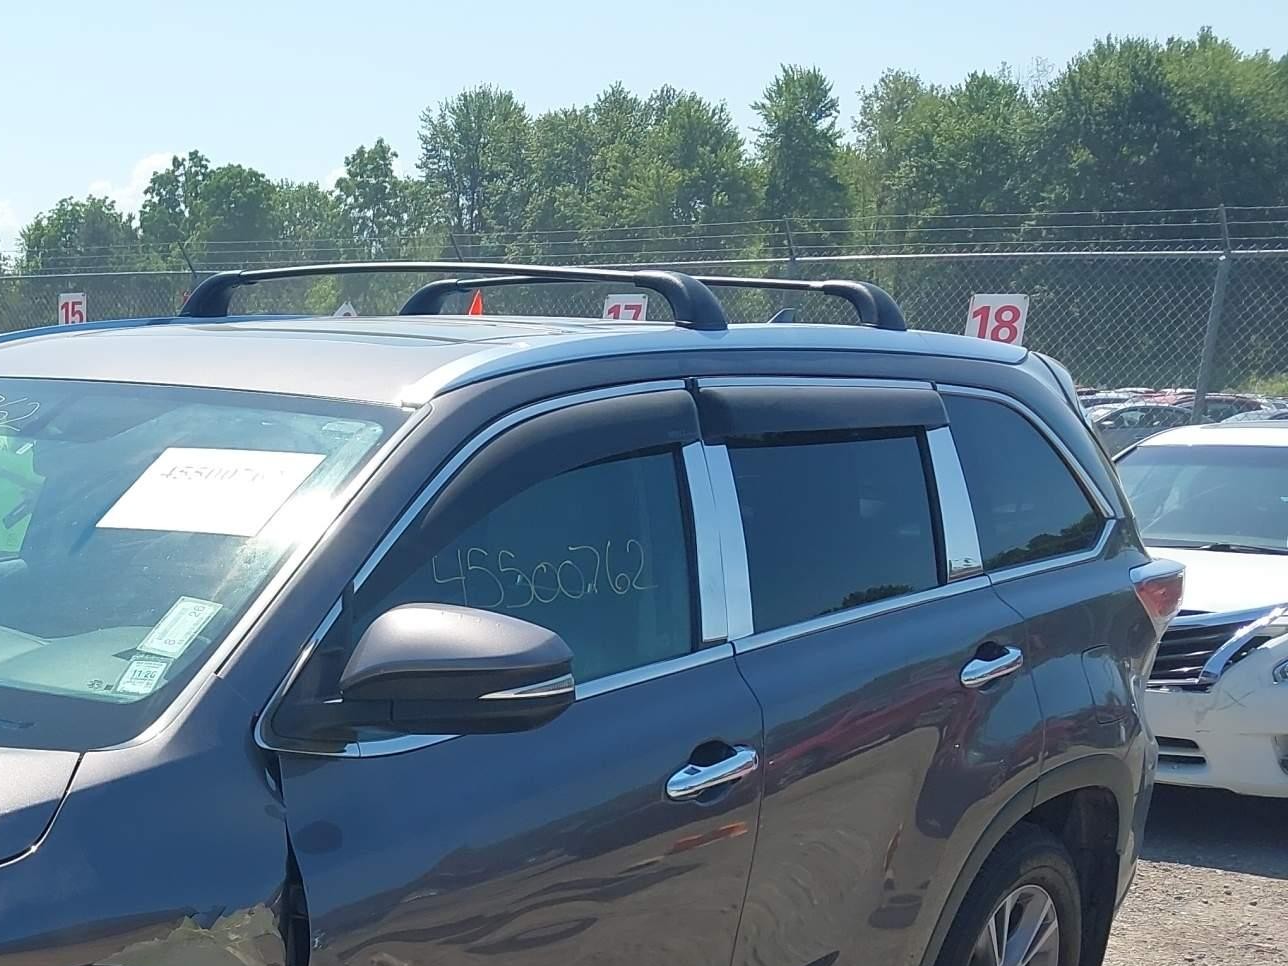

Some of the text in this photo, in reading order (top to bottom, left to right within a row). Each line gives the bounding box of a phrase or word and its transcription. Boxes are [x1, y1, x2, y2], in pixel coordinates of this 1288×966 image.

[61, 301, 84, 325] 15
[607, 304, 643, 321] 17
[972, 305, 1021, 344] 18
[432, 539, 659, 609] 45500762
